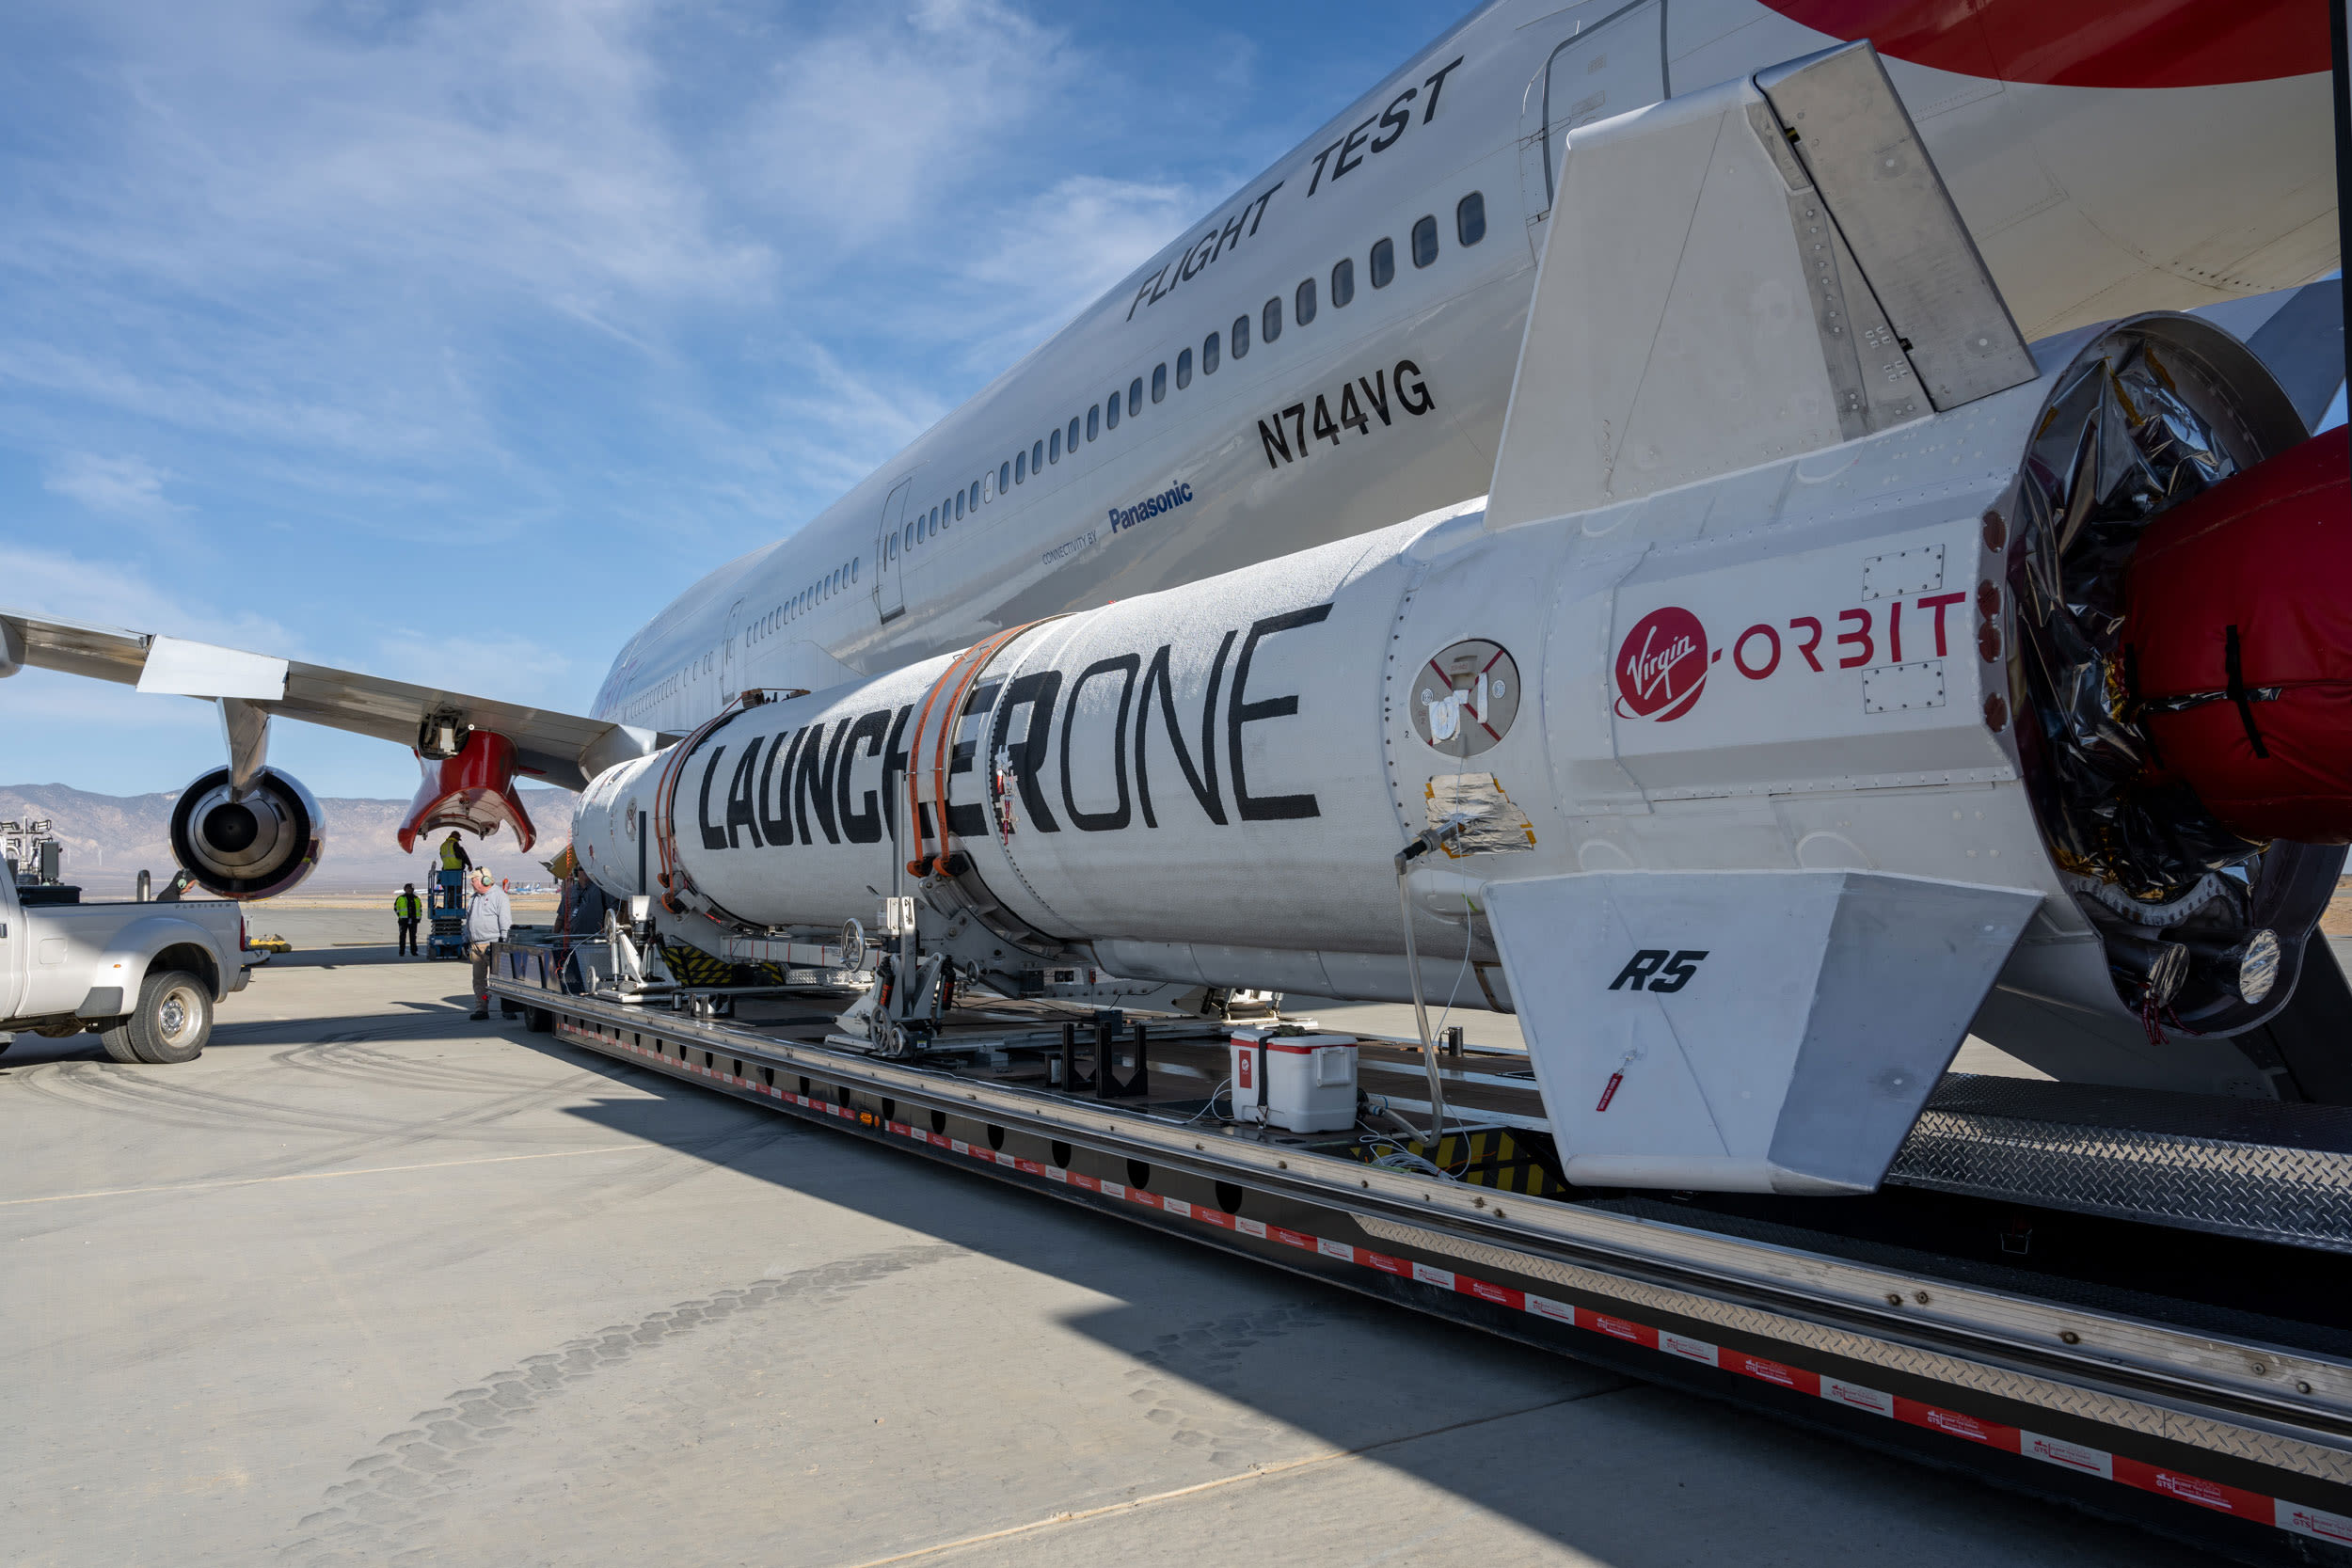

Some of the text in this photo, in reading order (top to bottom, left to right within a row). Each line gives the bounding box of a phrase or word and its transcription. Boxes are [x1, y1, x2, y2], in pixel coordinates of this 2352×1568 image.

[1126, 55, 1464, 322] FLIGHT TEST
[1257, 359, 1436, 468] N744VG
[1108, 479, 1193, 533] Panasonic
[1041, 530, 1097, 565] CONNECTIVITY BY
[1733, 591, 1966, 681] ORBIT
[1627, 626, 1696, 700] Virgin
[1607, 949, 1710, 993] R5
[2034, 1446, 2048, 1455] GTS
[2156, 1480, 2171, 1490] GTS
[2293, 1518, 2311, 1528] GTS
